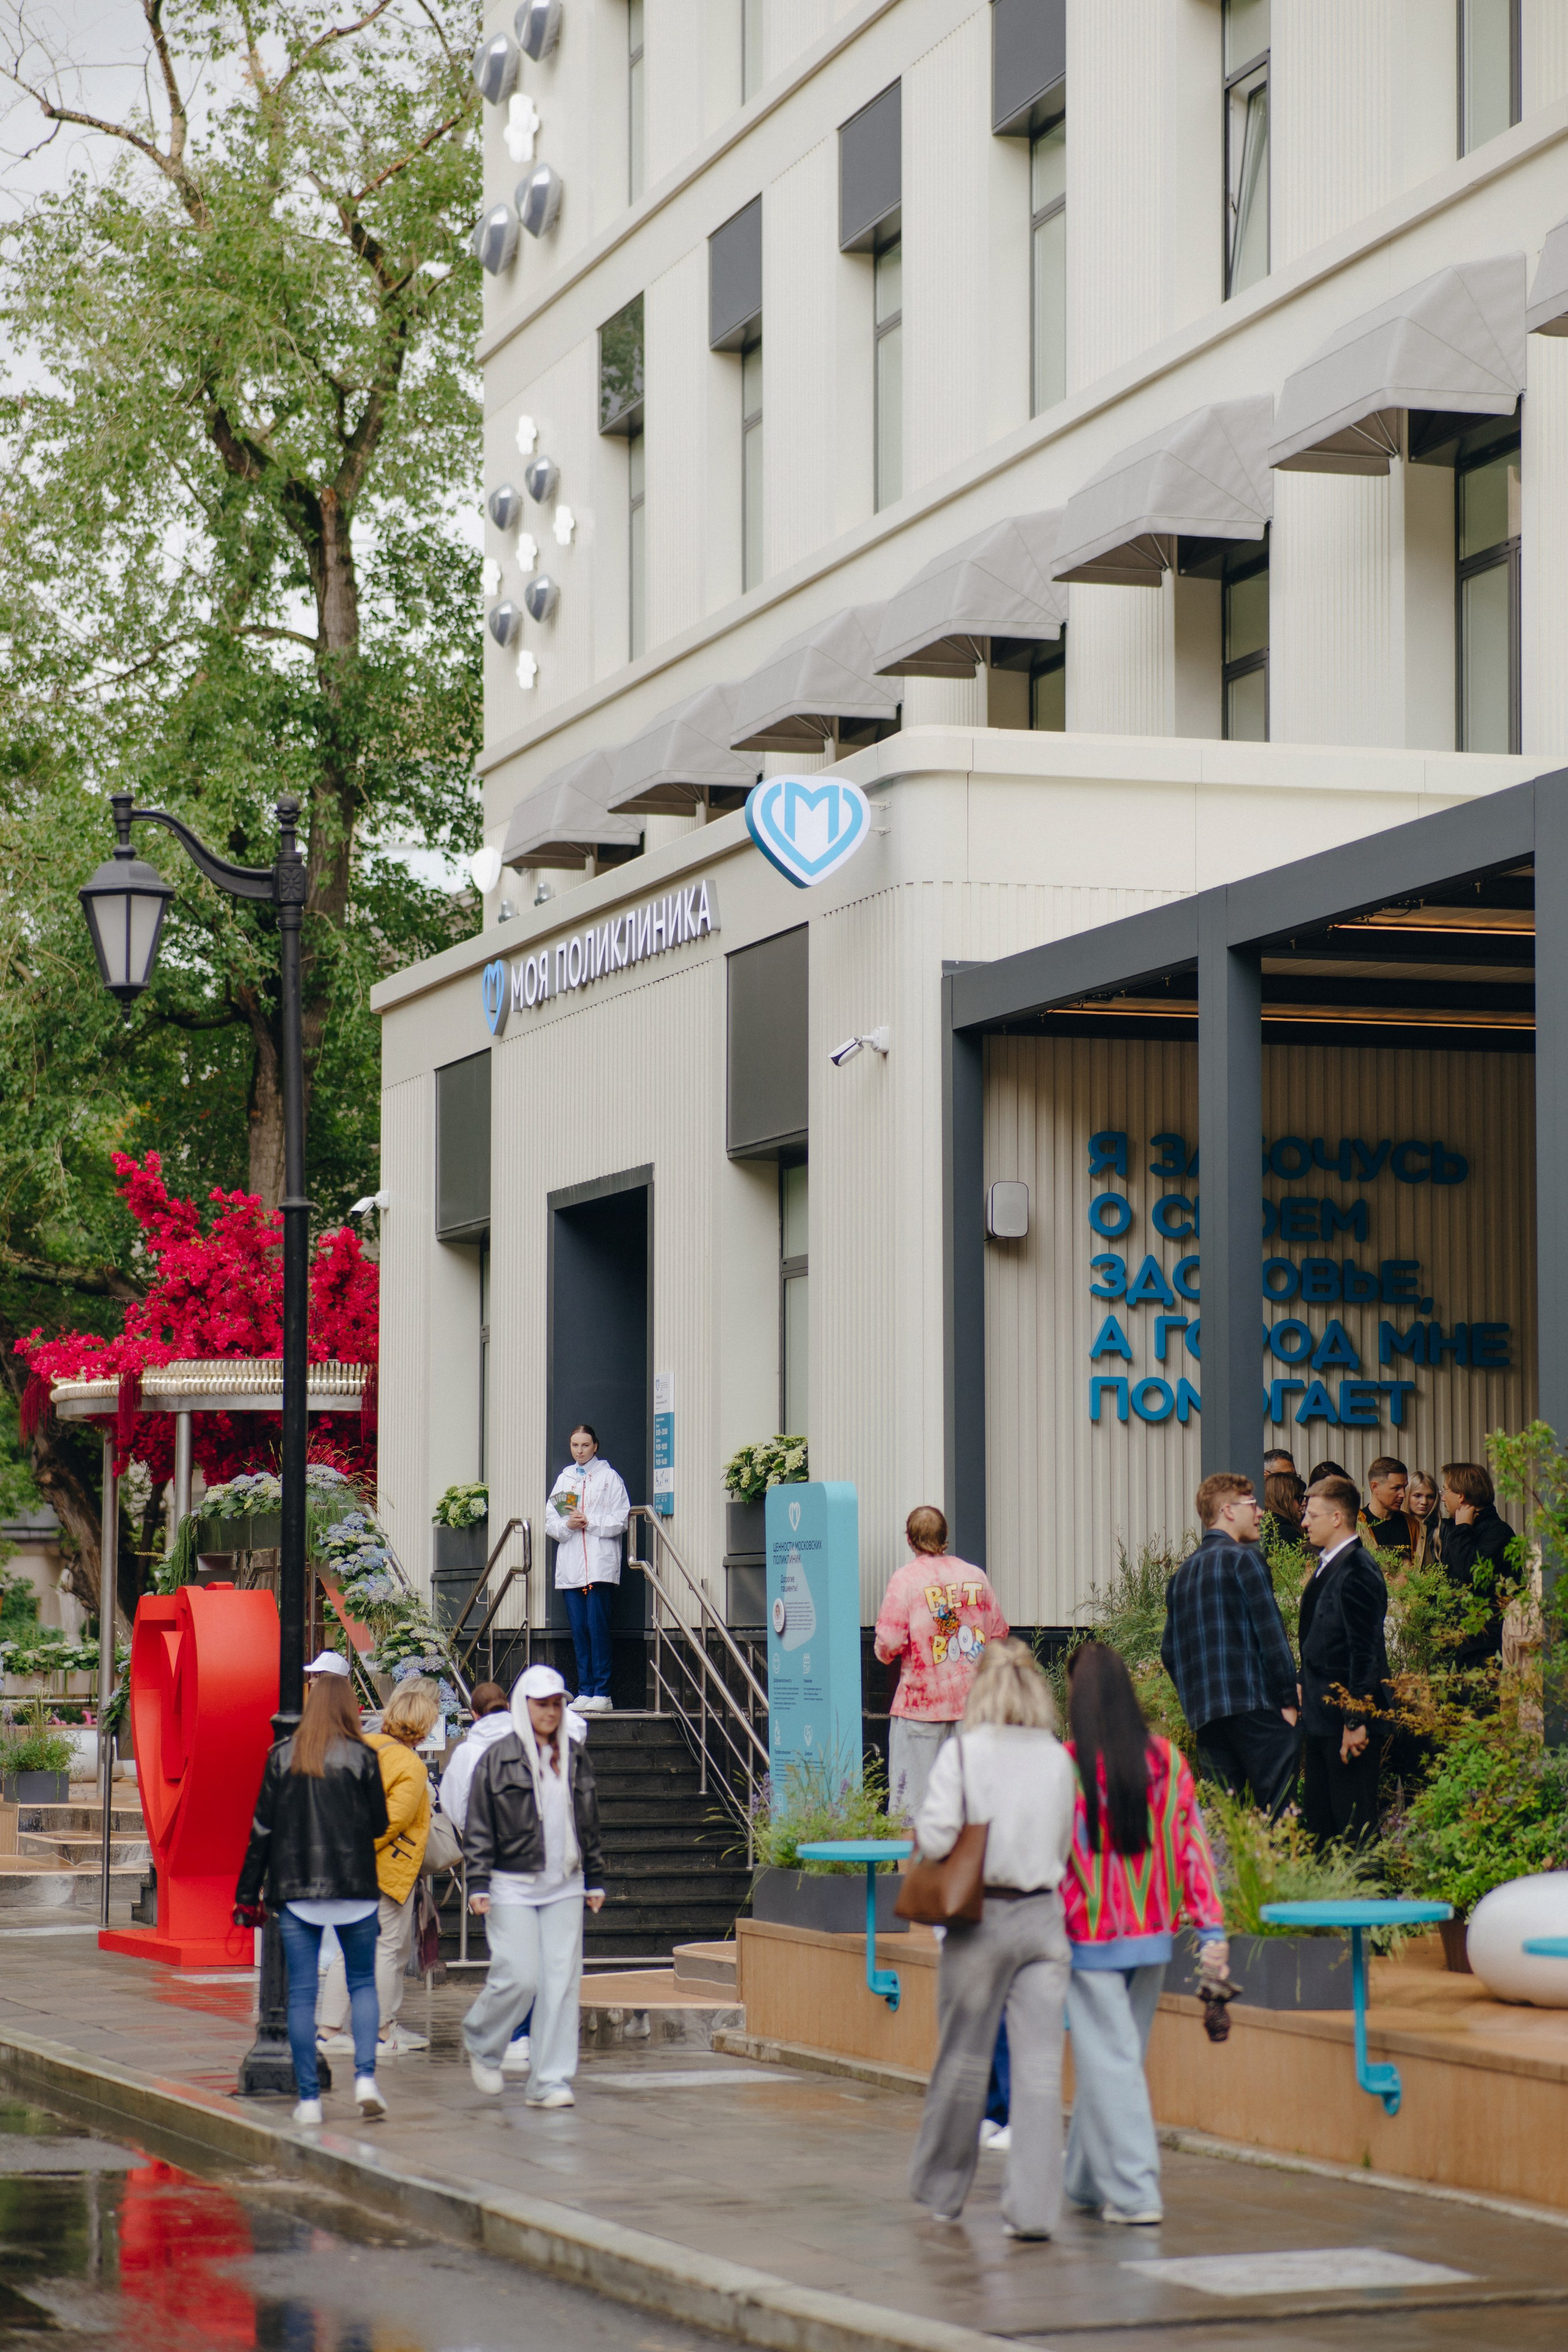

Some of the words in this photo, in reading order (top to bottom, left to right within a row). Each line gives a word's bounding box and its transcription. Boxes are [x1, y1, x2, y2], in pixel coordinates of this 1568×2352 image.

[511, 950, 550, 1012] МОЯ
[556, 880, 714, 993] ПОЛИКЛИНИКА
[1088, 1131, 1128, 1176] Я
[1149, 1133, 1469, 1185] ЗОЧУСЬ
[1088, 1192, 1132, 1236] О
[1152, 1194, 1367, 1243] СЕМ
[1089, 1253, 1434, 1315] ЗДООВЬЕ,
[1088, 1315, 1133, 1359] А
[1154, 1316, 1360, 1371] ГОД
[1379, 1321, 1511, 1367] МНЕ
[772, 1541, 794, 1553] ЦЕННОСТИ
[795, 1539, 823, 1551] МОСКОВСКИХ
[772, 1554, 801, 1565] ПОЛИКЛИНИК
[924, 1581, 984, 1613] BET
